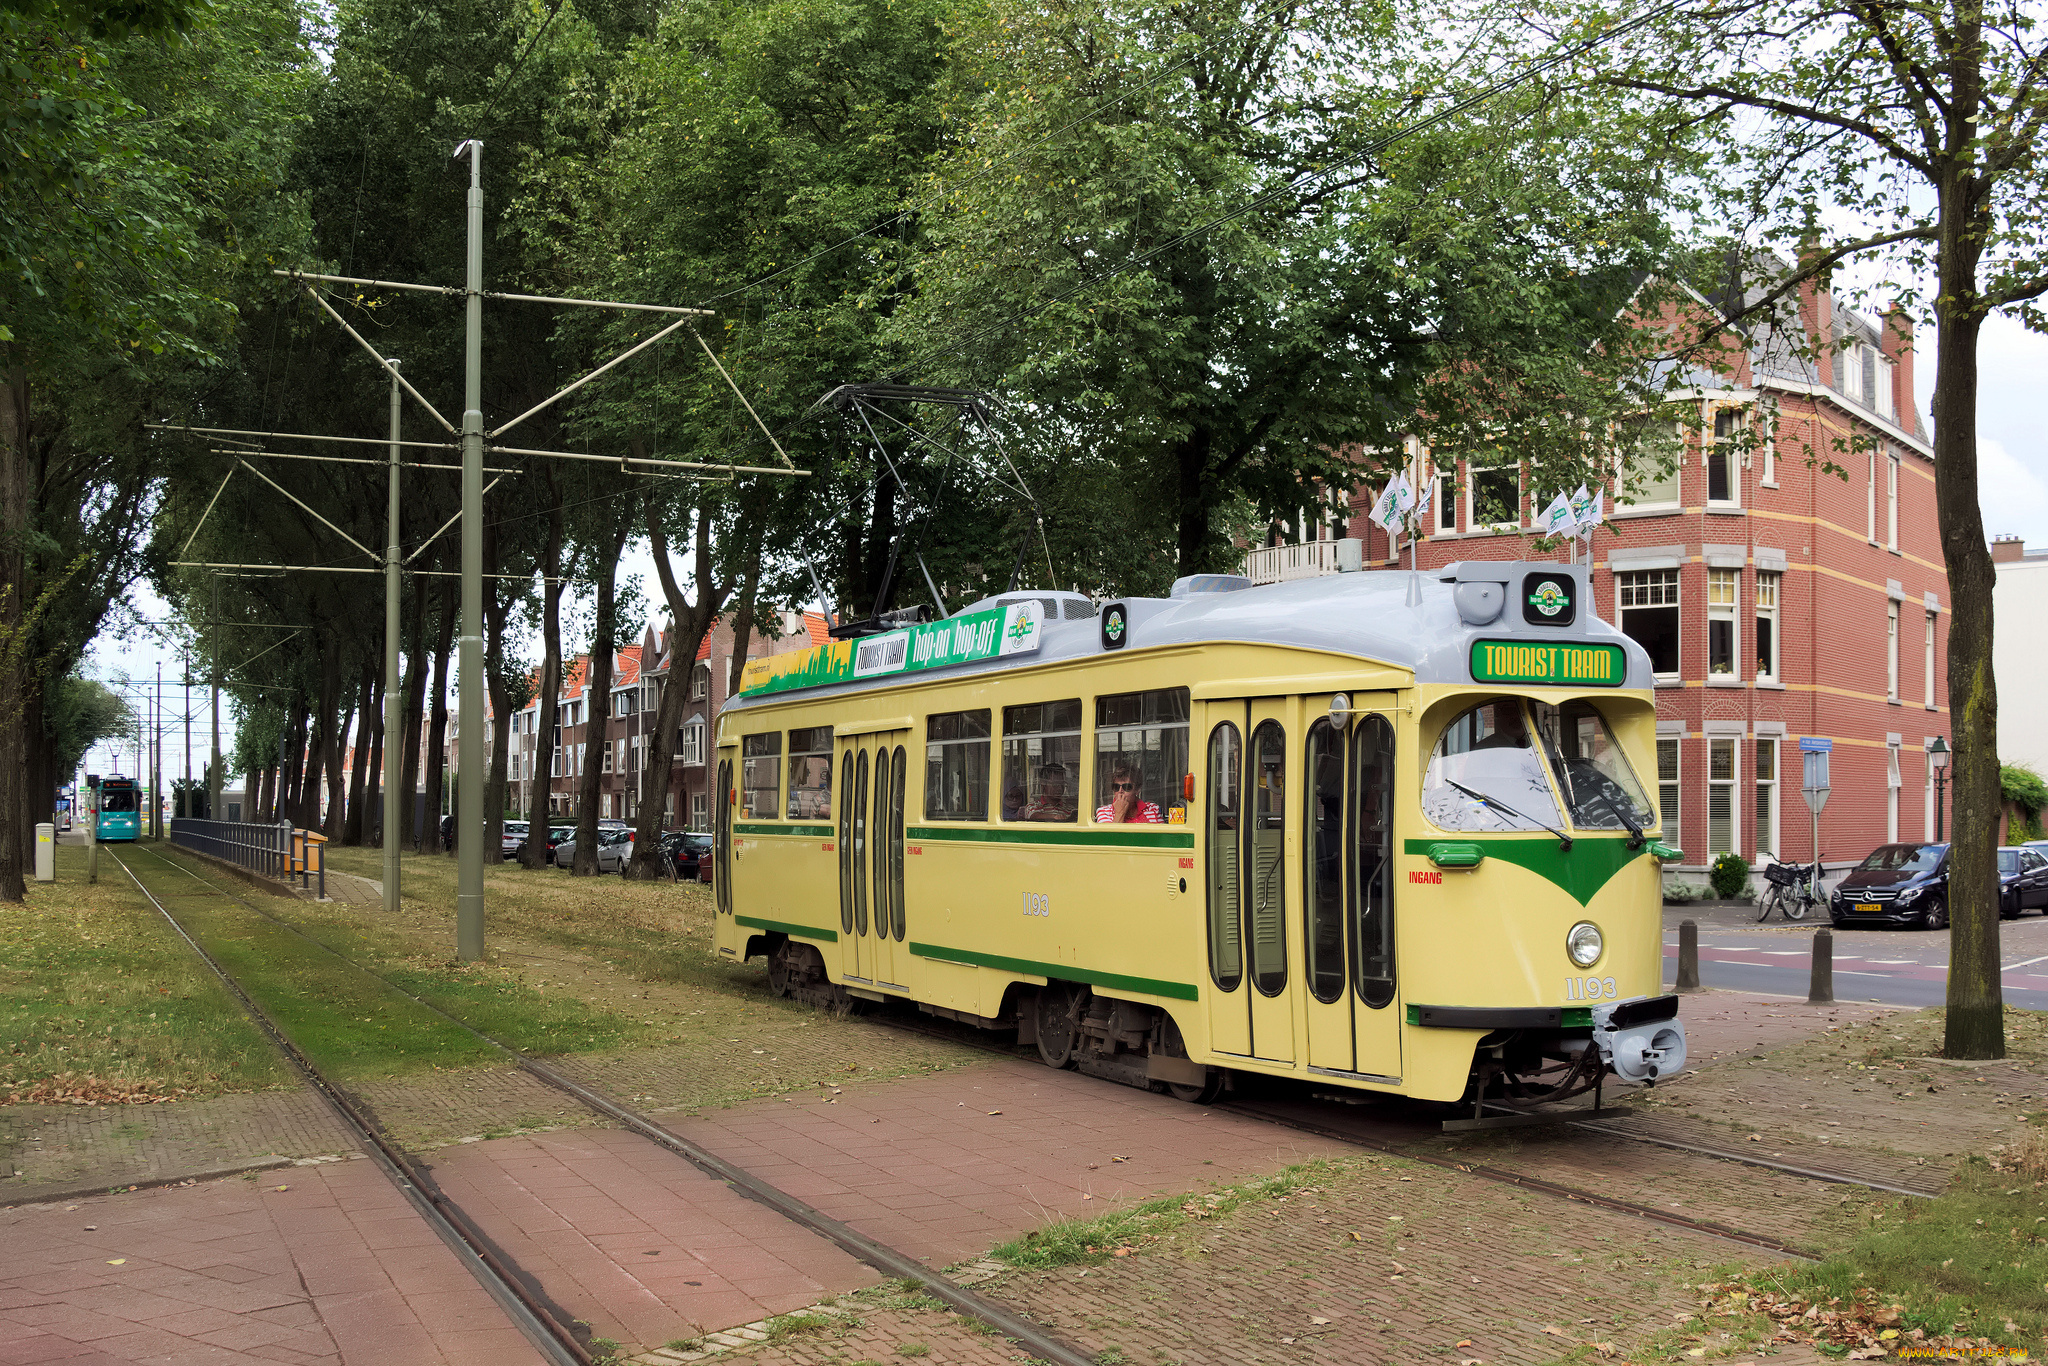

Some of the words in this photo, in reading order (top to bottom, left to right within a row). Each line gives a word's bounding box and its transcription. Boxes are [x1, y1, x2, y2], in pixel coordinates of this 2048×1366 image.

[857, 642, 886, 671] TOURIST
[884, 638, 906, 666] TRAM
[912, 628, 951, 667] hop-on
[953, 618, 998, 659] hop-off
[1484, 645, 1557, 677] TOURIST
[1561, 648, 1611, 679] TRAM
[1178, 858, 1194, 869] INGANG
[1408, 871, 1442, 885] INGANG
[1022, 891, 1050, 917] 1193
[1565, 976, 1618, 1000] 1193
